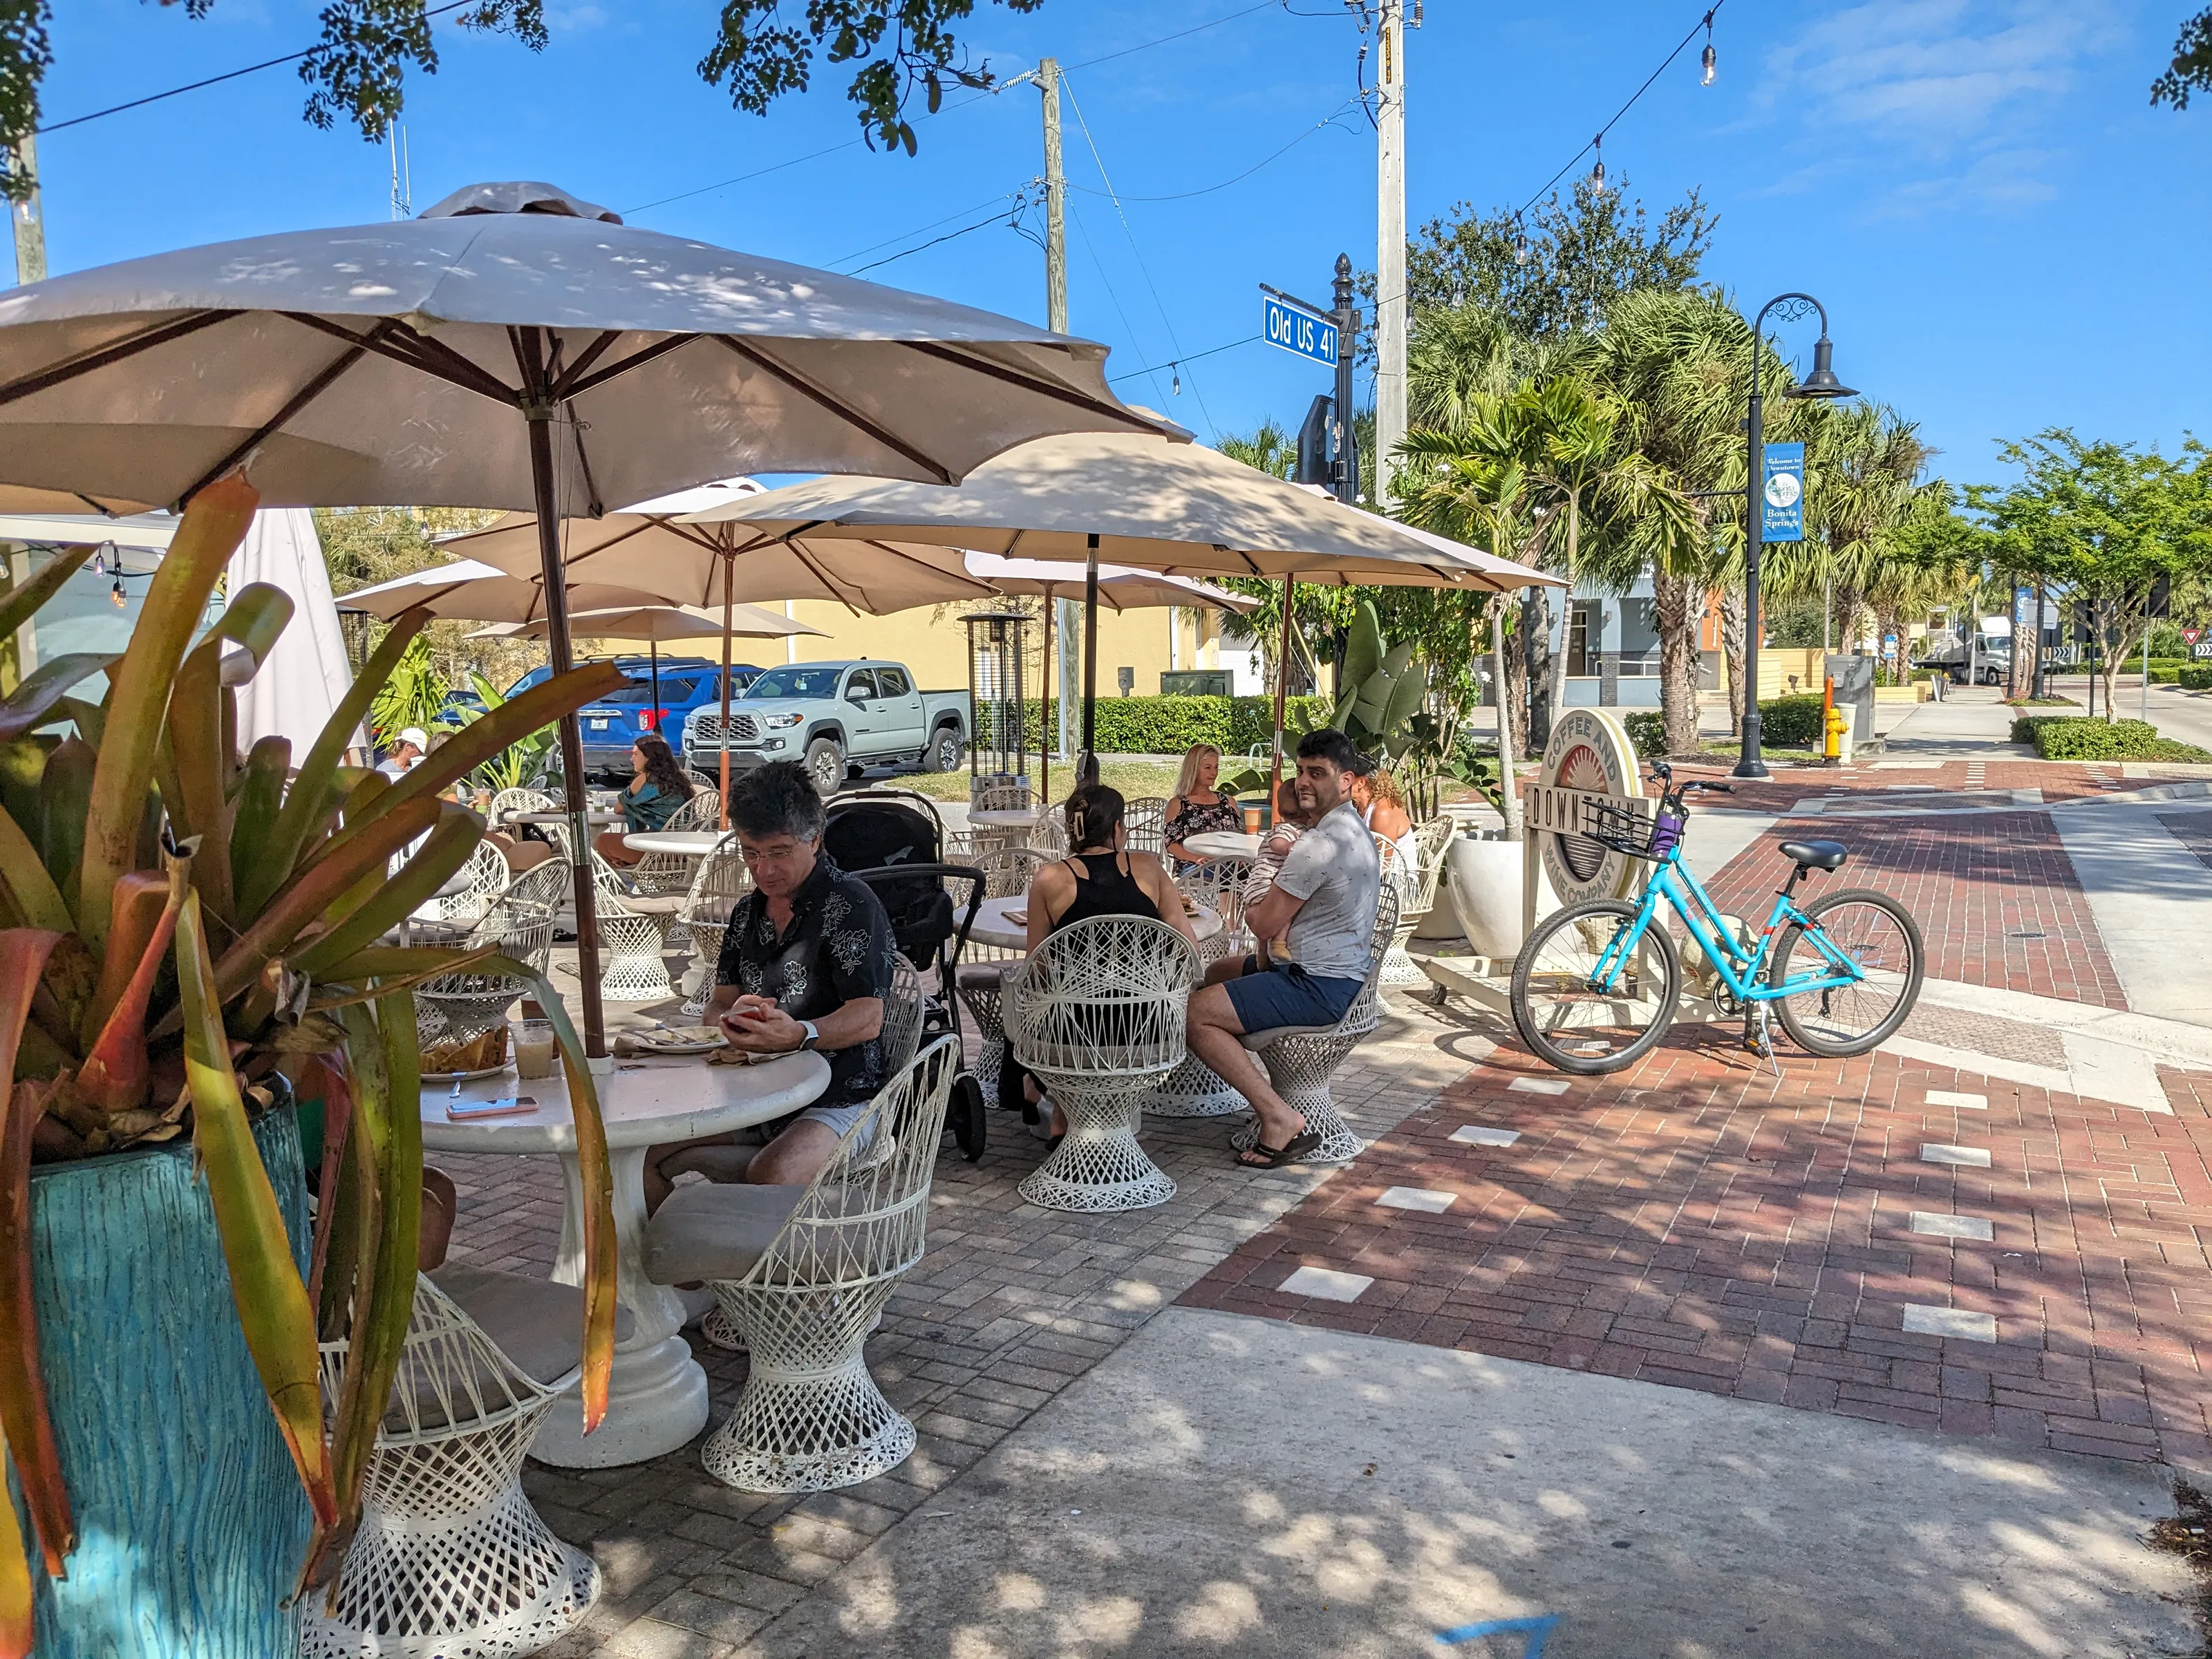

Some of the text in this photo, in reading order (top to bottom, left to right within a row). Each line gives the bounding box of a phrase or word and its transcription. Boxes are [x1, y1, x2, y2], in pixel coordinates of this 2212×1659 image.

[1387, 70, 1391, 82] 17
[1270, 306, 1333, 359] Old US 41
[1765, 518, 1799, 529] Springs
[1767, 509, 1797, 518] Bonita
[1548, 717, 1615, 781] COFFEE AND
[1546, 841, 1615, 903] WINE COMPANY
